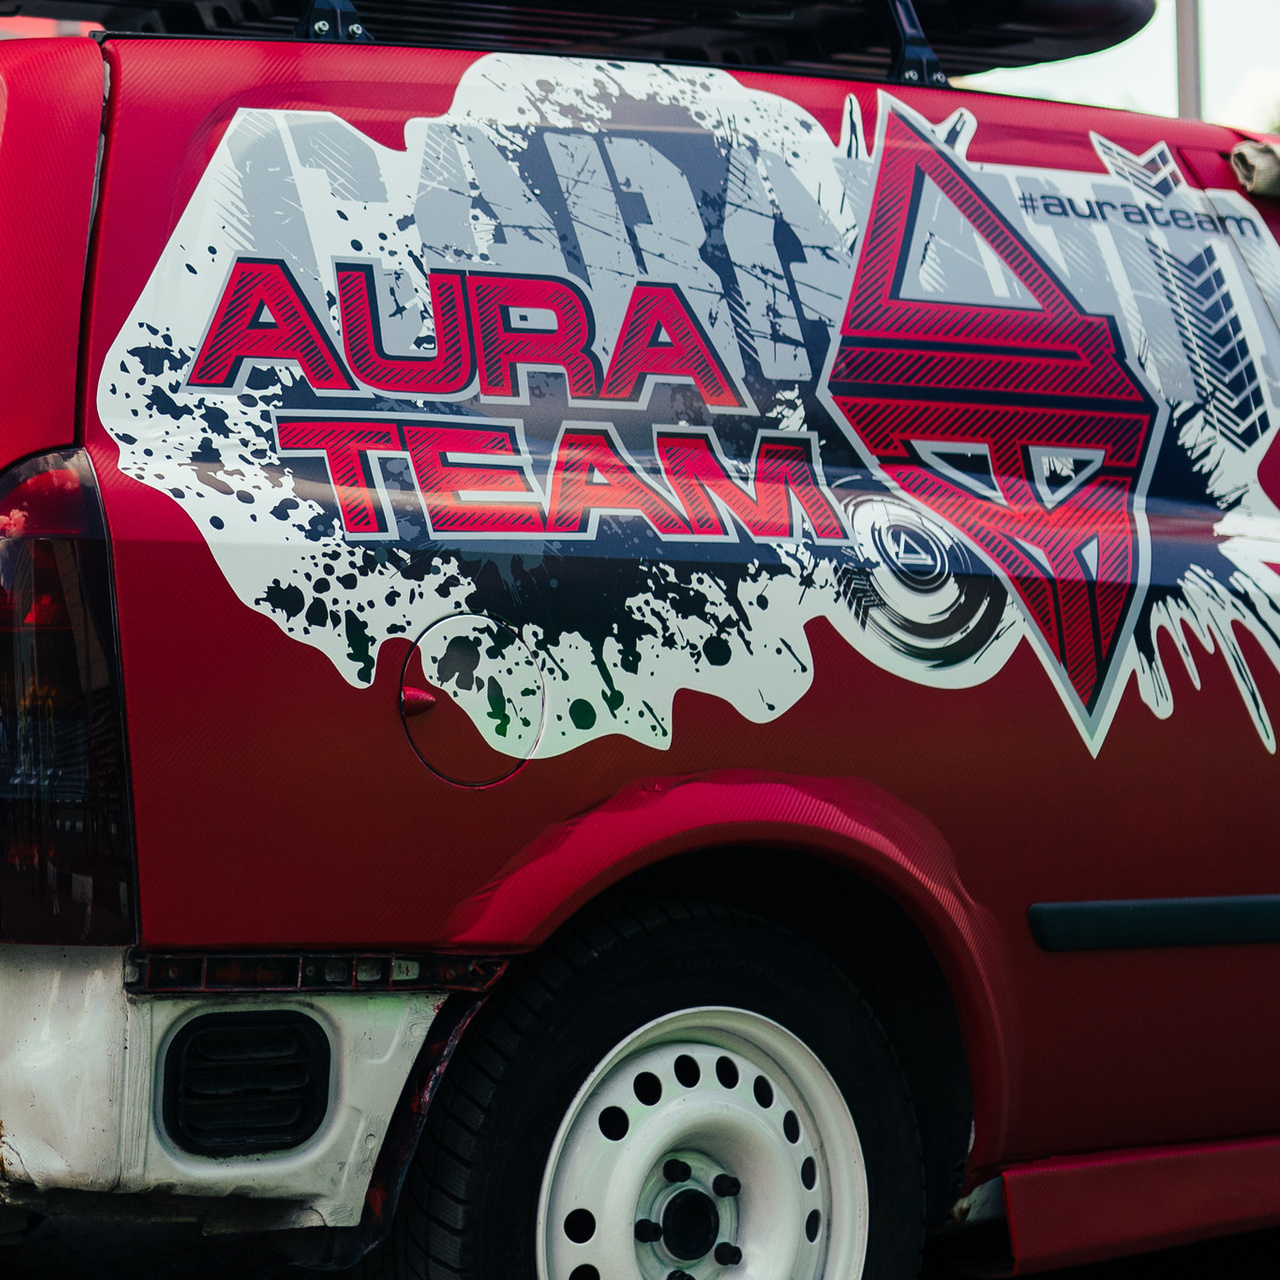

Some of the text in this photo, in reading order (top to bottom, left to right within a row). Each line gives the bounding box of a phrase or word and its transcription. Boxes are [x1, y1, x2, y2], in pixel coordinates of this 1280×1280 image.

[1019, 192, 1261, 238] #aurateam
[185, 257, 756, 412] AURA
[275, 415, 853, 542] TEAM
